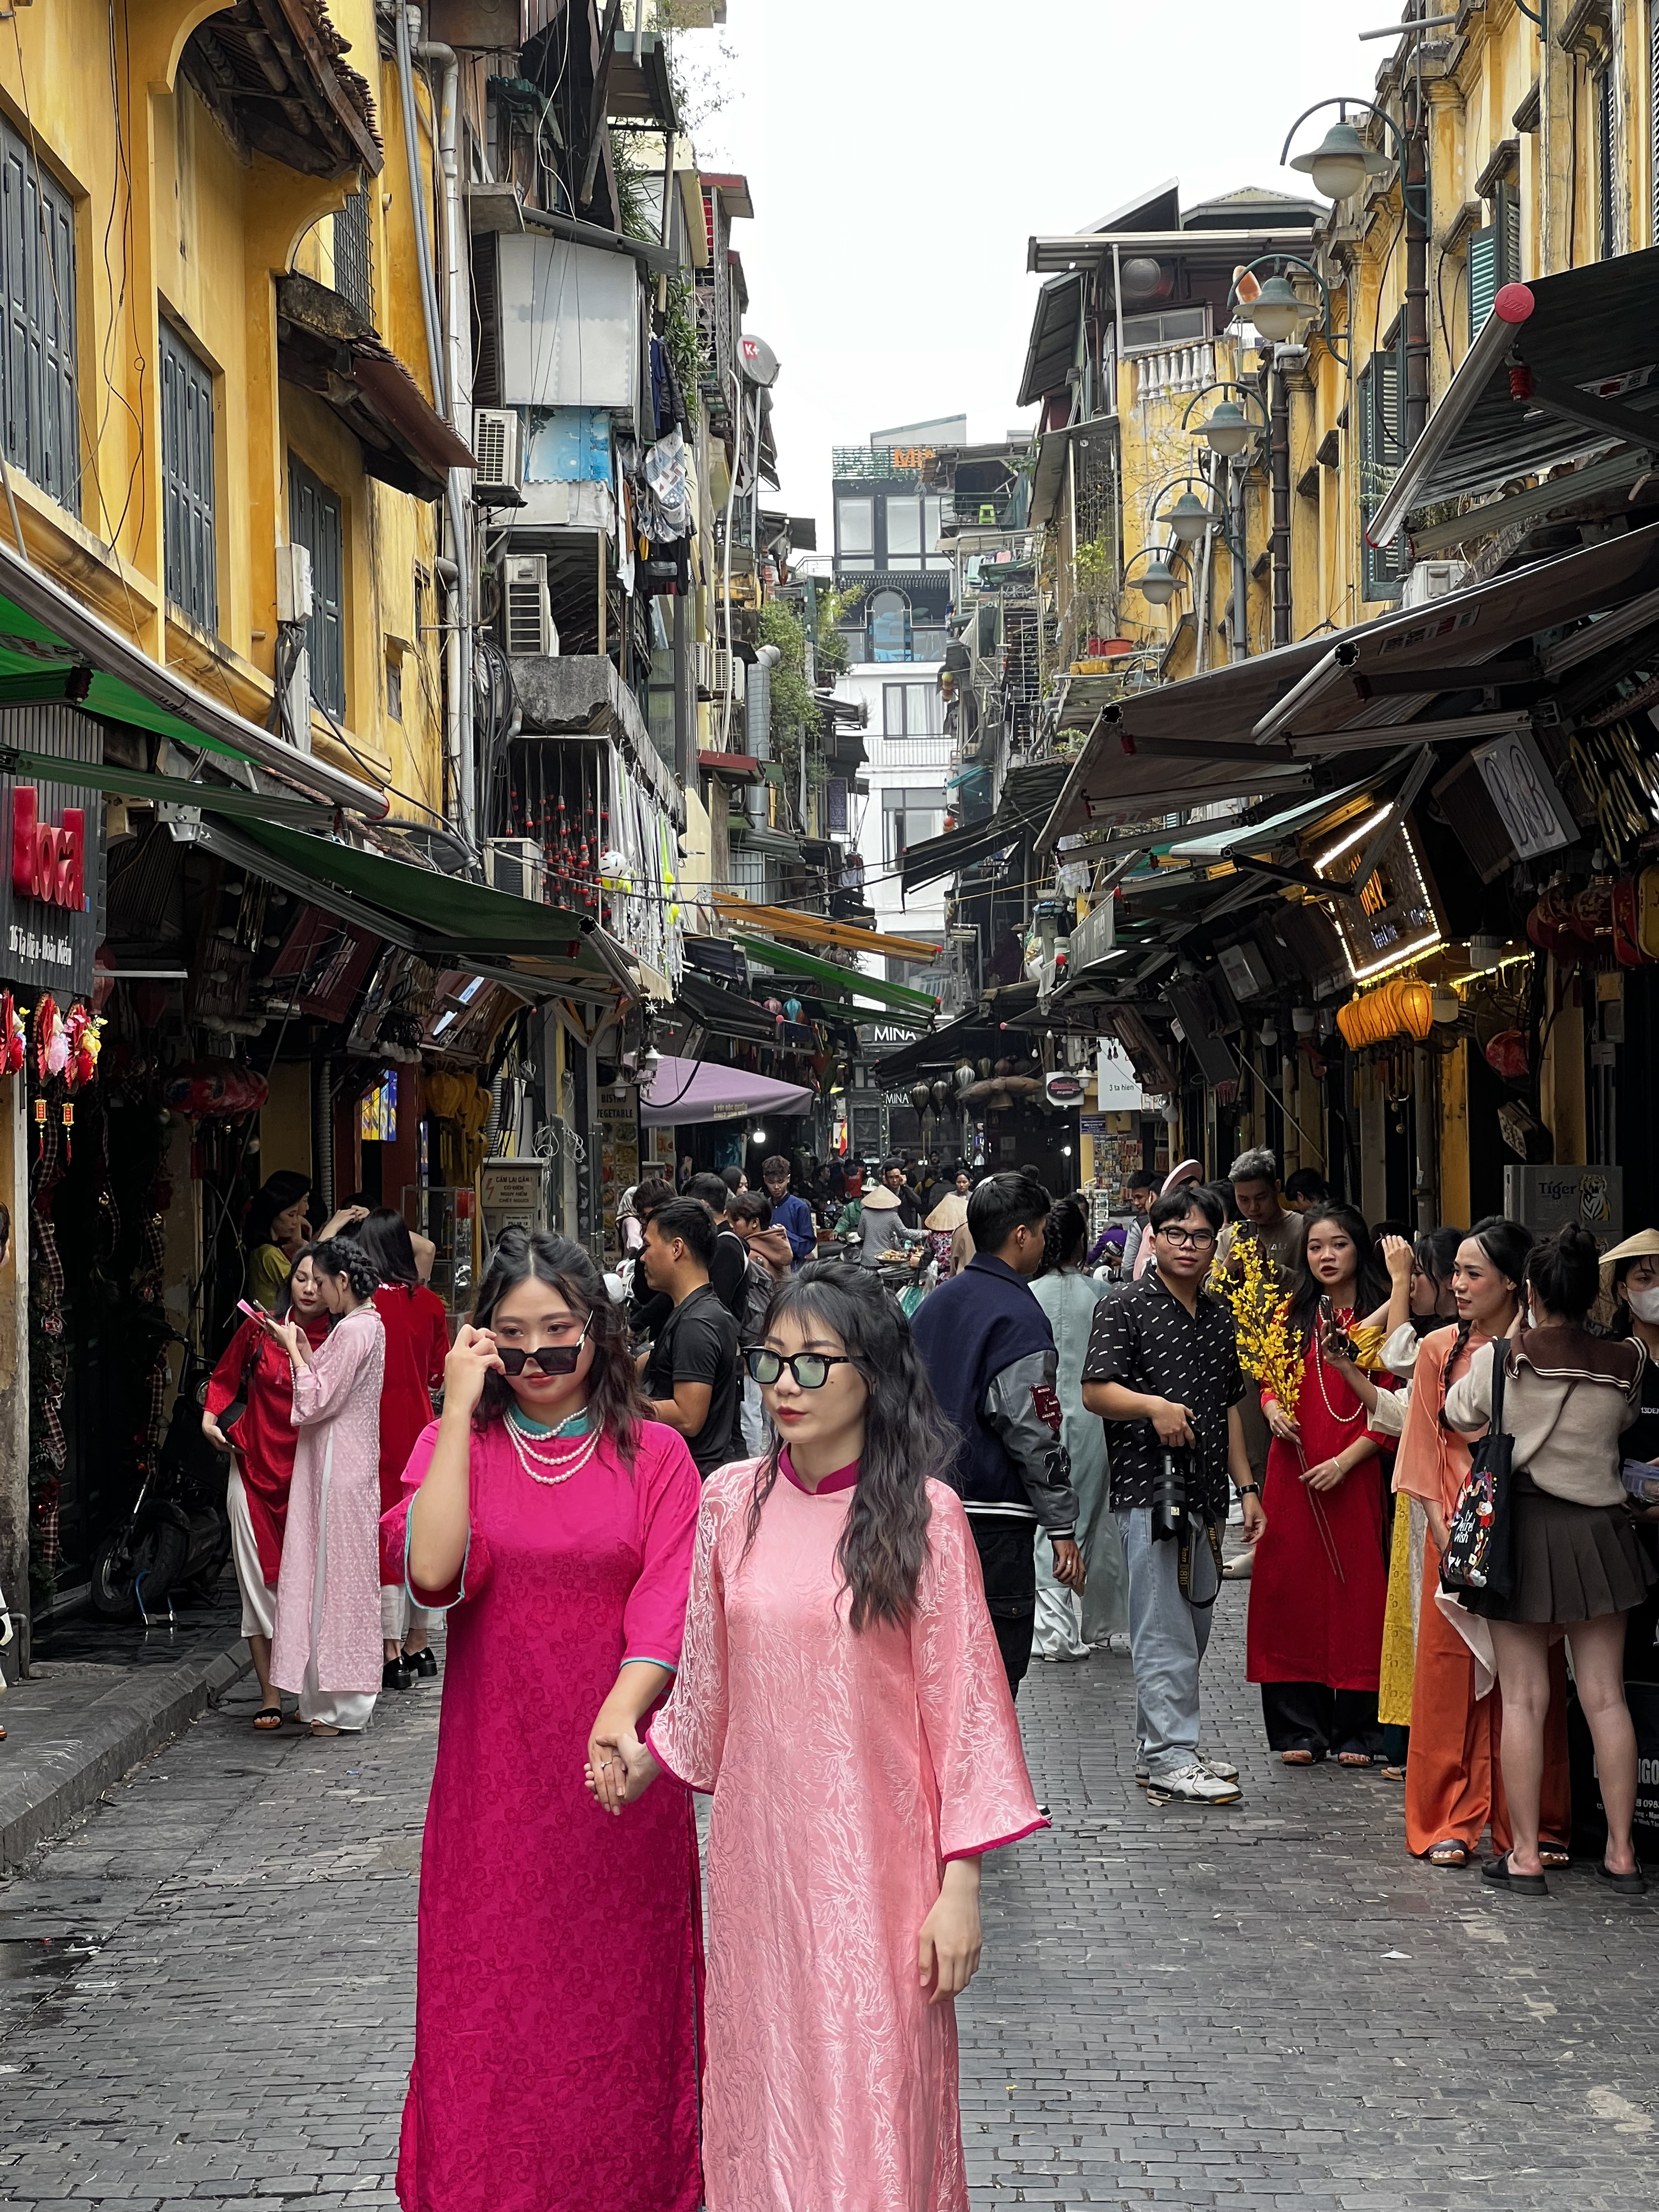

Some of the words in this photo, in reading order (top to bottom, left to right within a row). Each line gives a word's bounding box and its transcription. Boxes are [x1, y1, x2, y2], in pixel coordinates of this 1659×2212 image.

[745, 343, 760, 356] K+
[874, 1025, 917, 1041] MINA
[885, 1092, 909, 1104] MINA
[1538, 1180, 1577, 1200] Tiger
